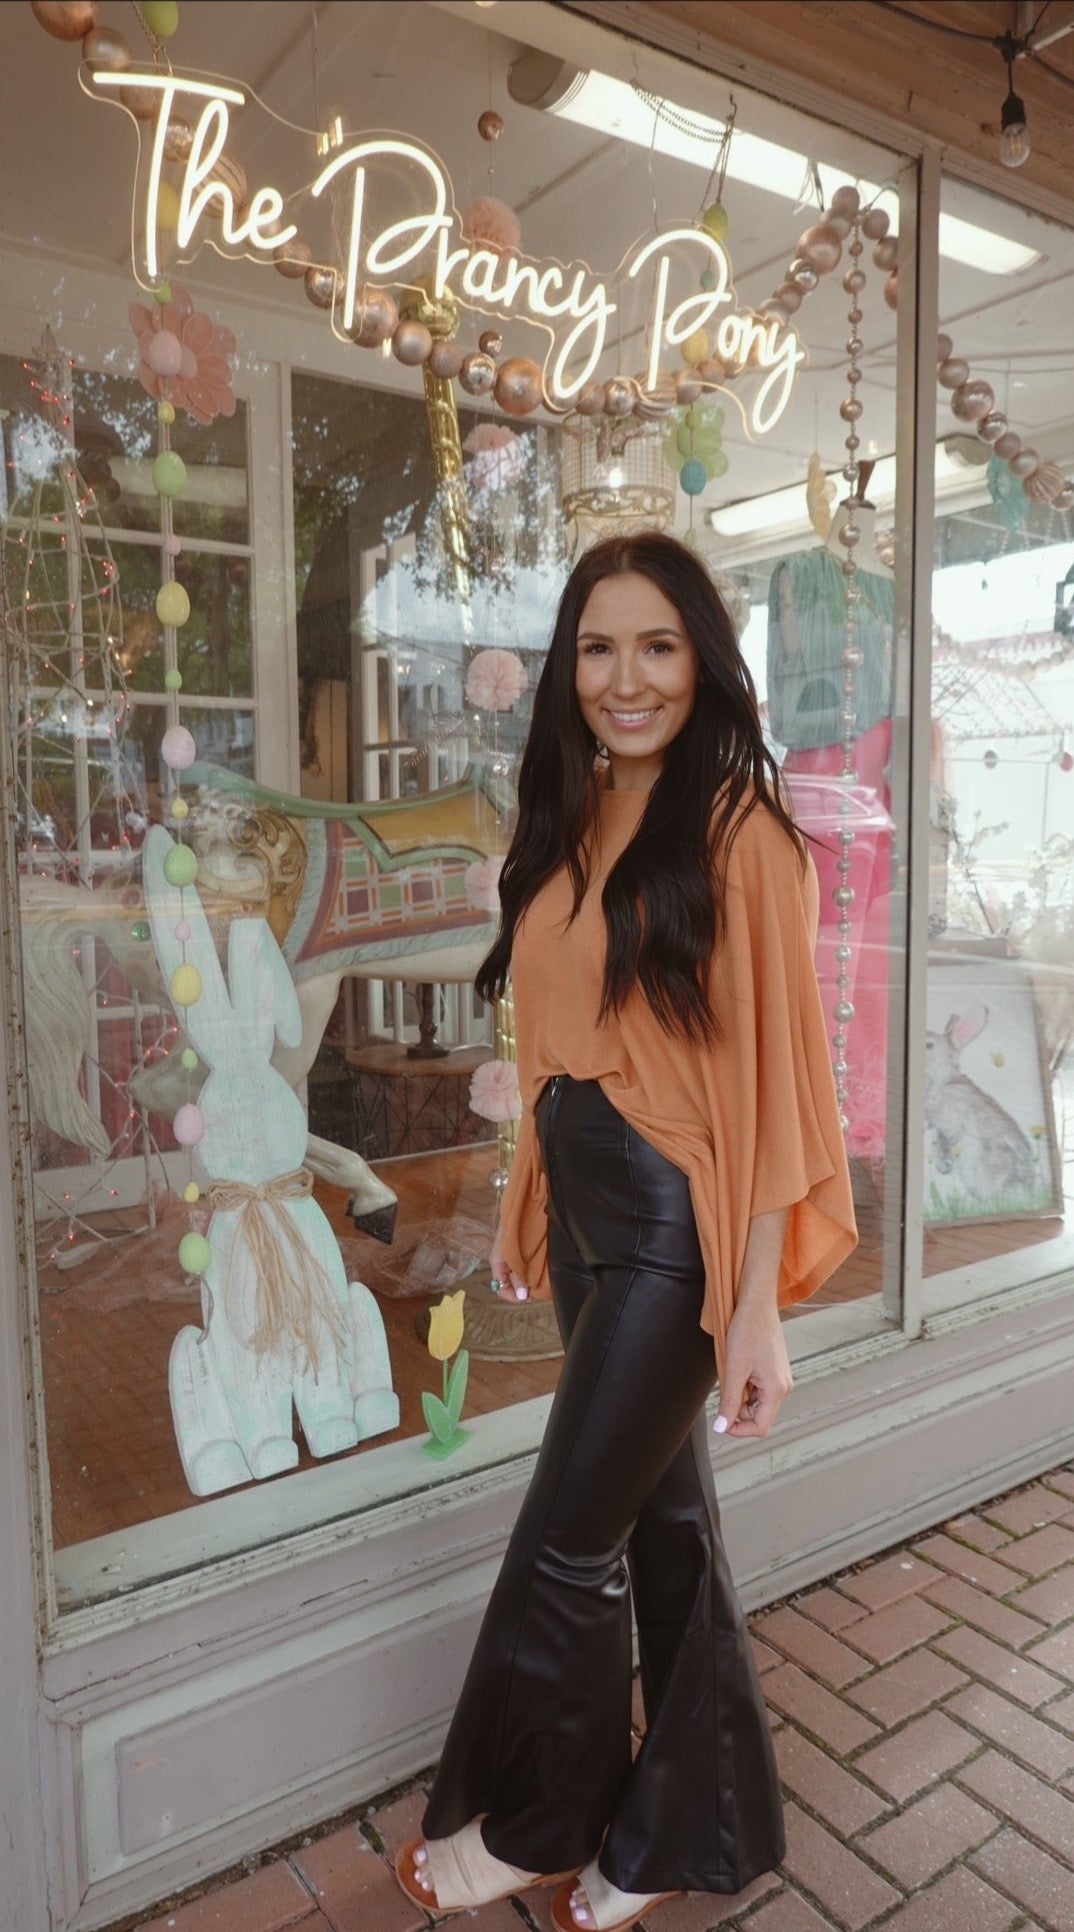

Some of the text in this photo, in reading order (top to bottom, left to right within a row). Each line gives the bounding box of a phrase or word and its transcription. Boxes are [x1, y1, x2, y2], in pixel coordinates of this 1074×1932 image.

[92, 71, 806, 434] The Prancy Pony
